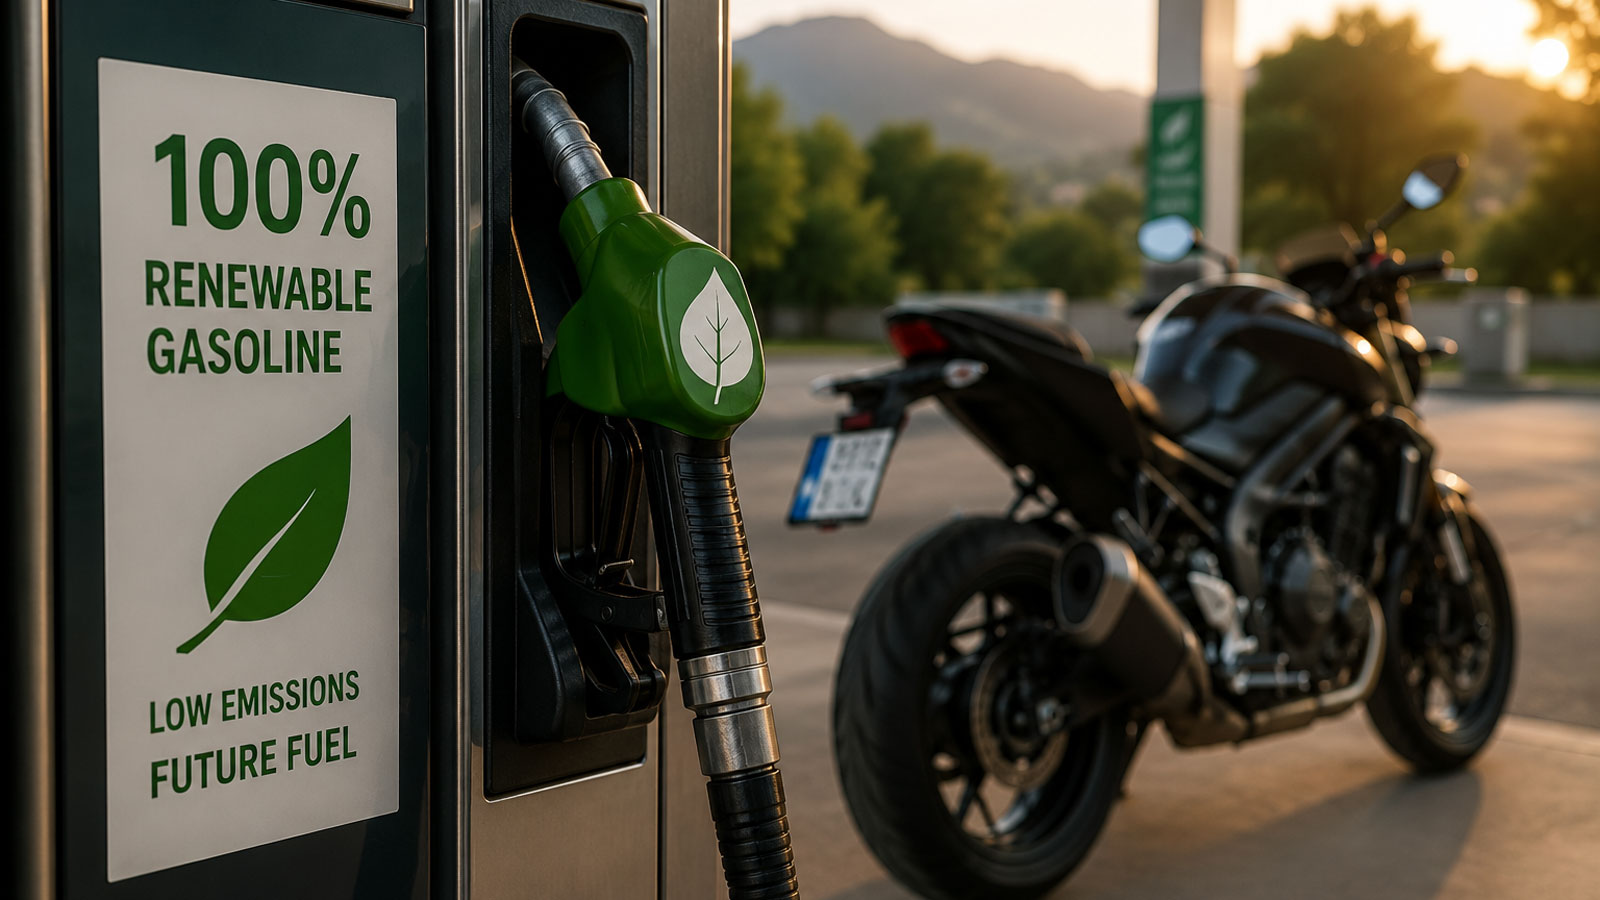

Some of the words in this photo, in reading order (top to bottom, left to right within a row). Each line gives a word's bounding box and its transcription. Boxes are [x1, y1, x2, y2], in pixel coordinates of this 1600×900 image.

[154, 133, 371, 239] 100%
[145, 259, 373, 312] RENEWABLE
[147, 327, 342, 375] GASOLINE
[150, 693, 212, 733] LOW
[221, 670, 360, 722] EMISSIONS
[151, 739, 277, 798] FUTURE
[287, 725, 357, 771] FUEL
